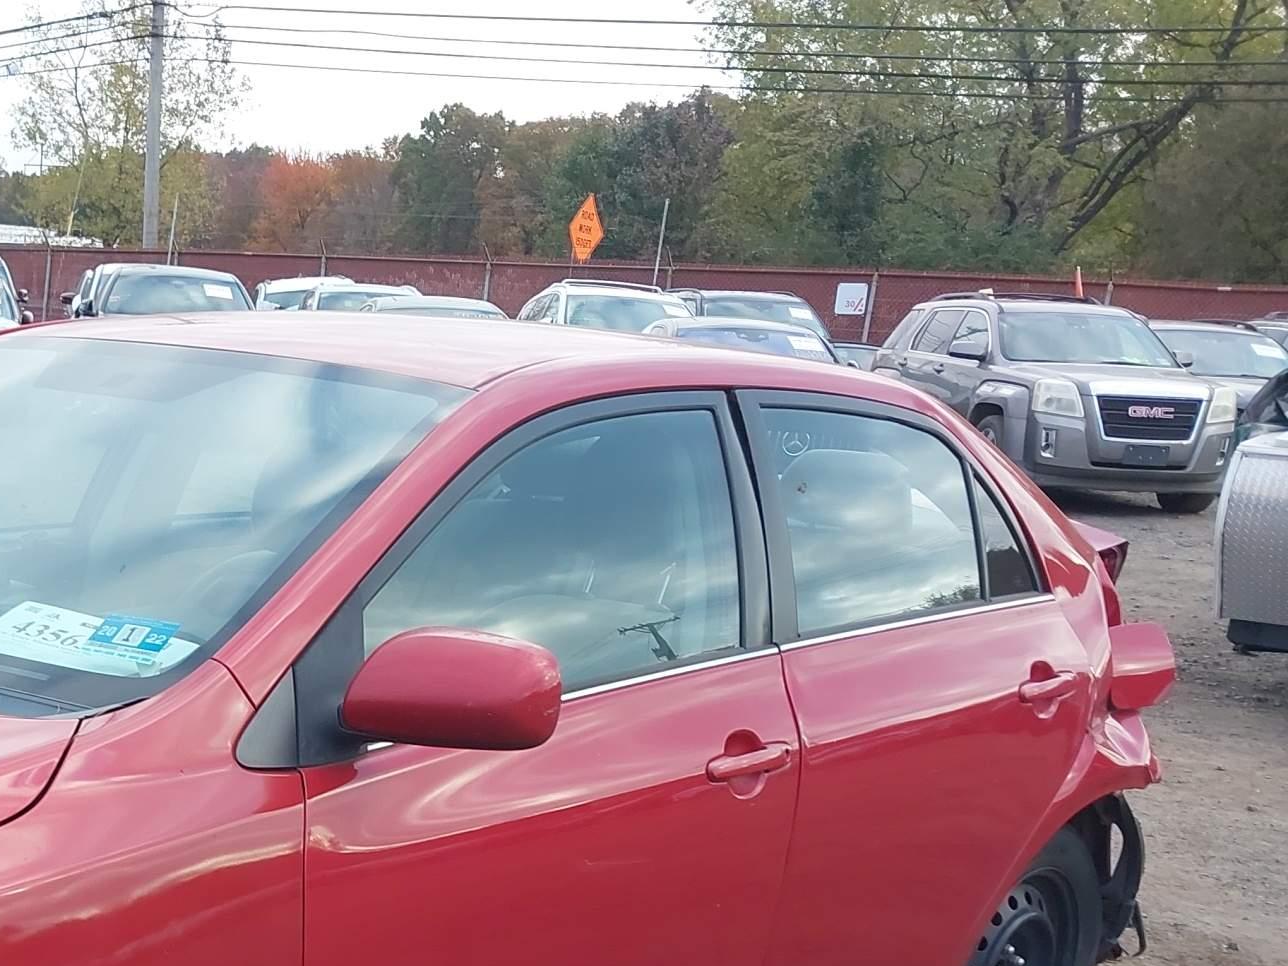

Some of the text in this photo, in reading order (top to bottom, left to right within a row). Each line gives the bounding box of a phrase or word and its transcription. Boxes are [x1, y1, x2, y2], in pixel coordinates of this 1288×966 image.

[1128, 406, 1175, 419] GMC
[98, 625, 118, 637] 20
[122, 627, 137, 642] 1
[145, 633, 167, 645] 22
